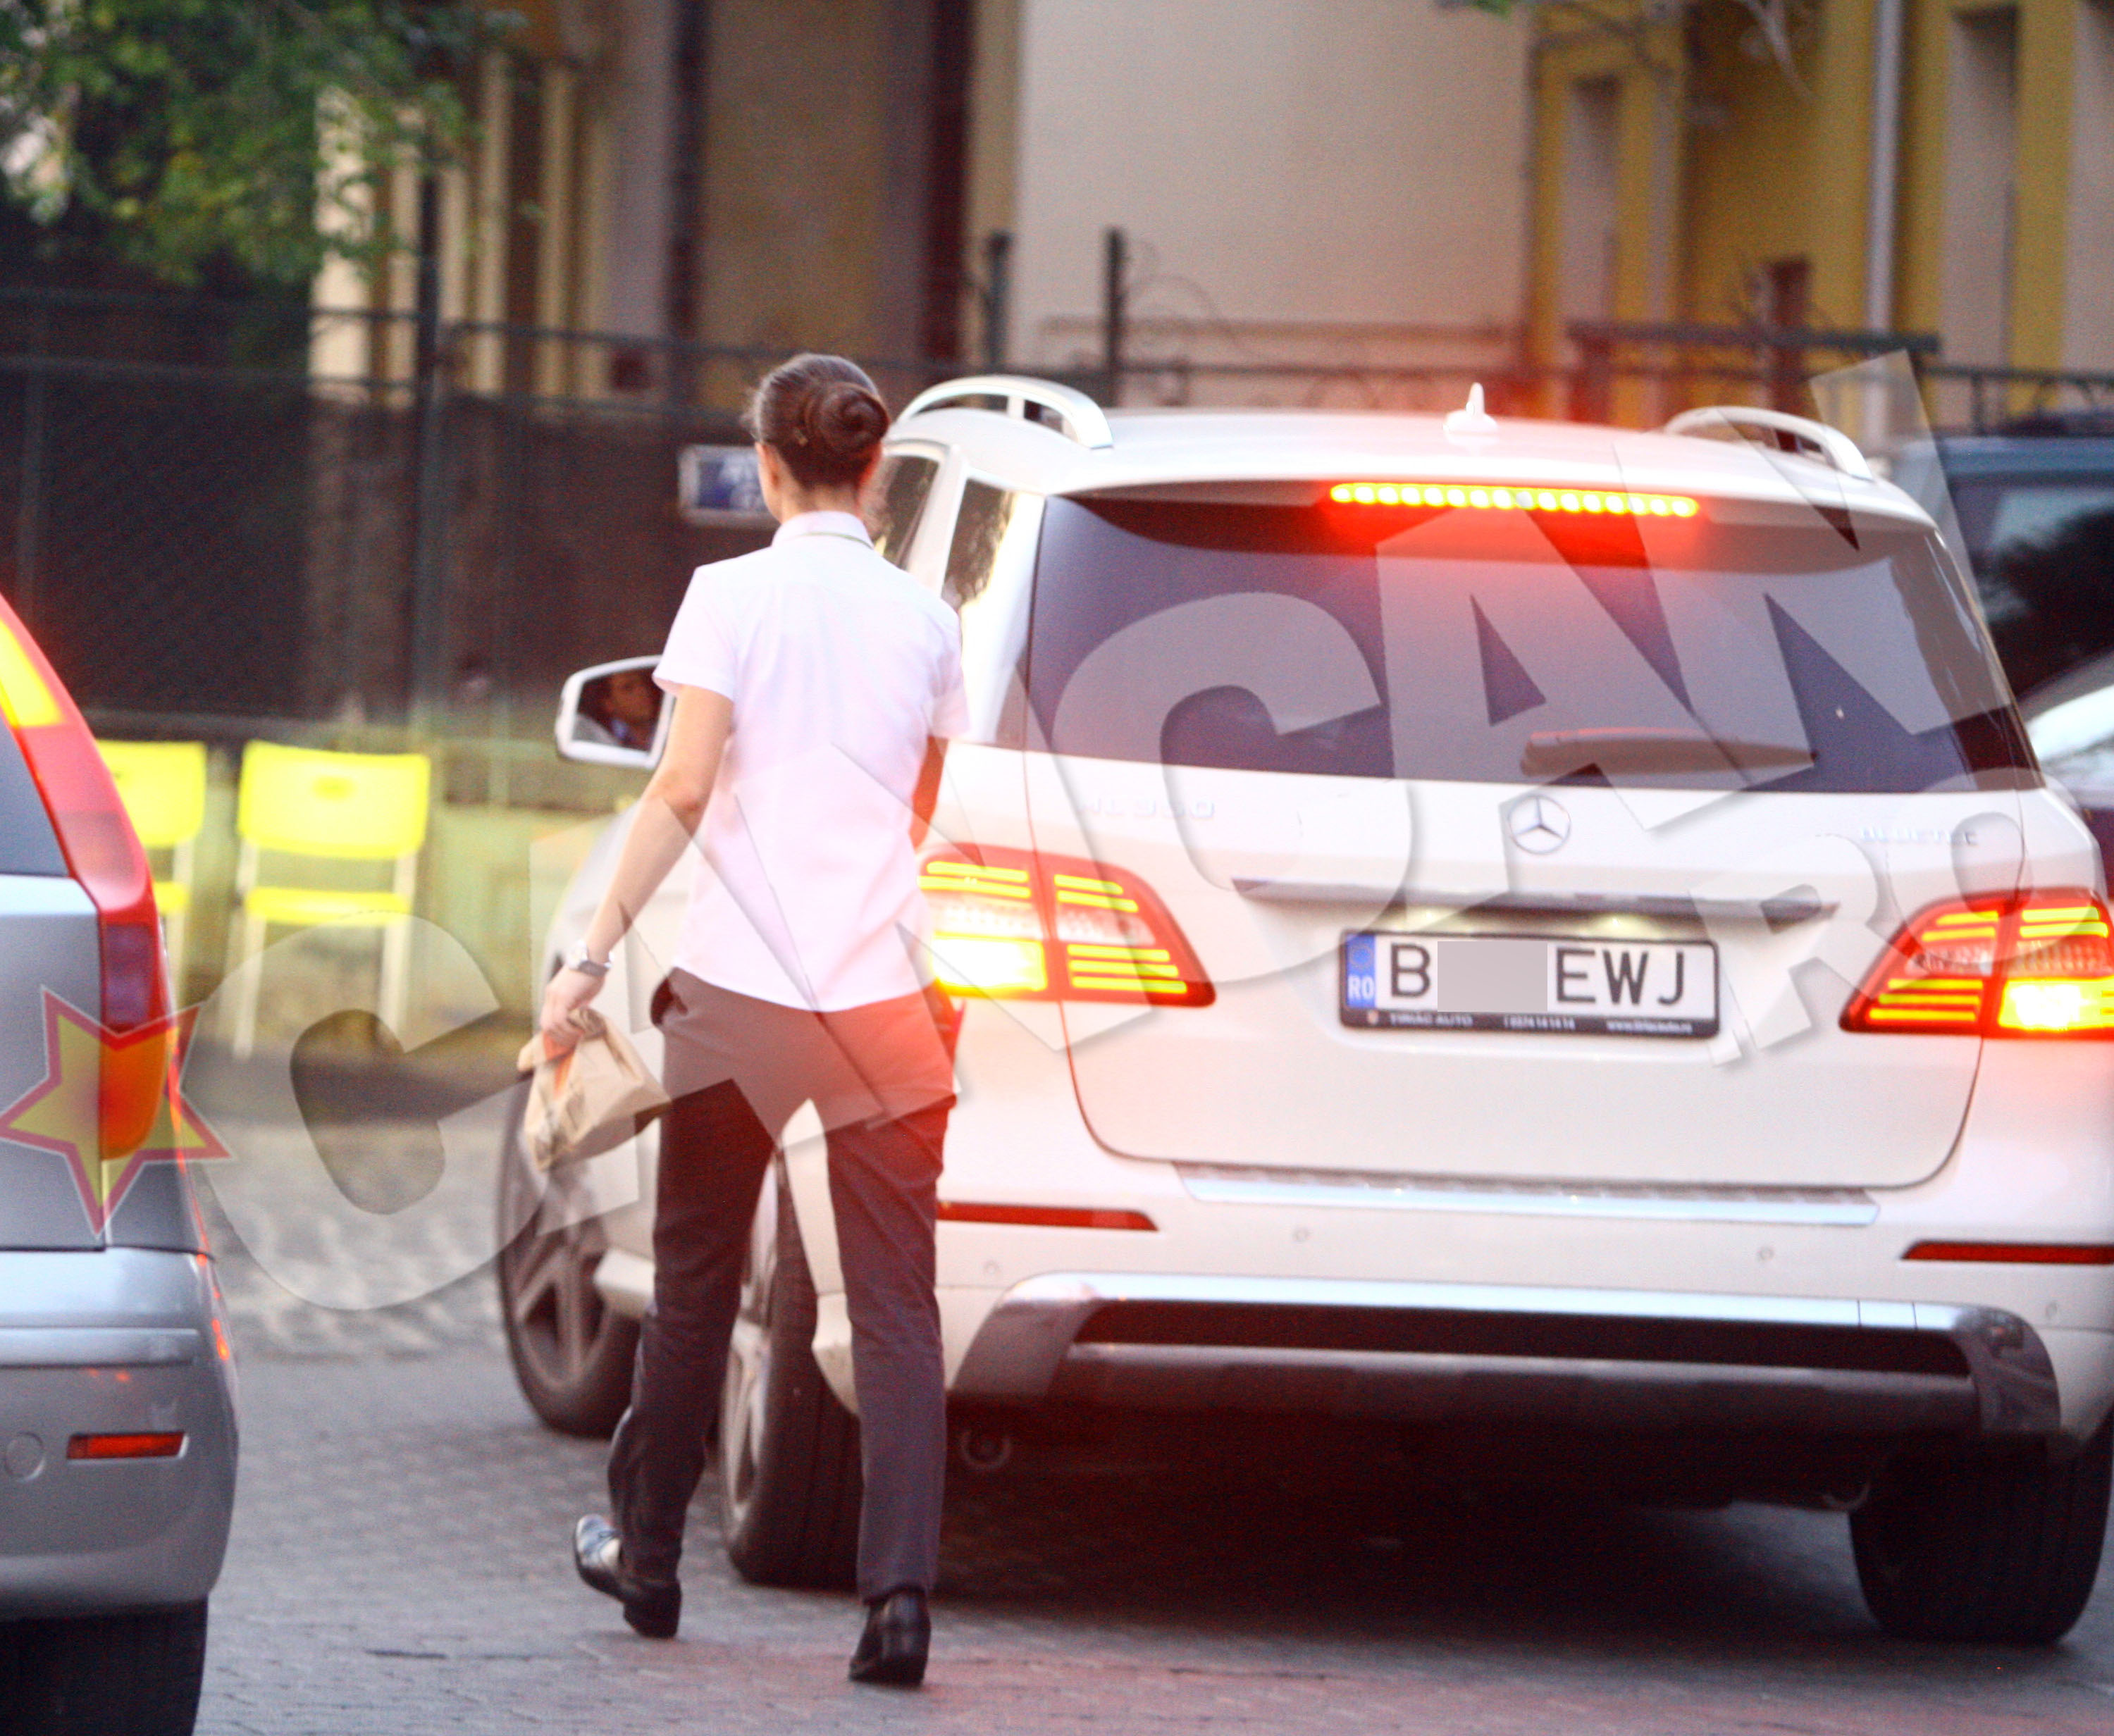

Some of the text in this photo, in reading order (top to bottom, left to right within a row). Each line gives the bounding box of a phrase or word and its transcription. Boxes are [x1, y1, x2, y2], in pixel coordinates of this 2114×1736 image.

[1347, 974, 1375, 1000] RO
[1390, 942, 1685, 1005] B EWJ
